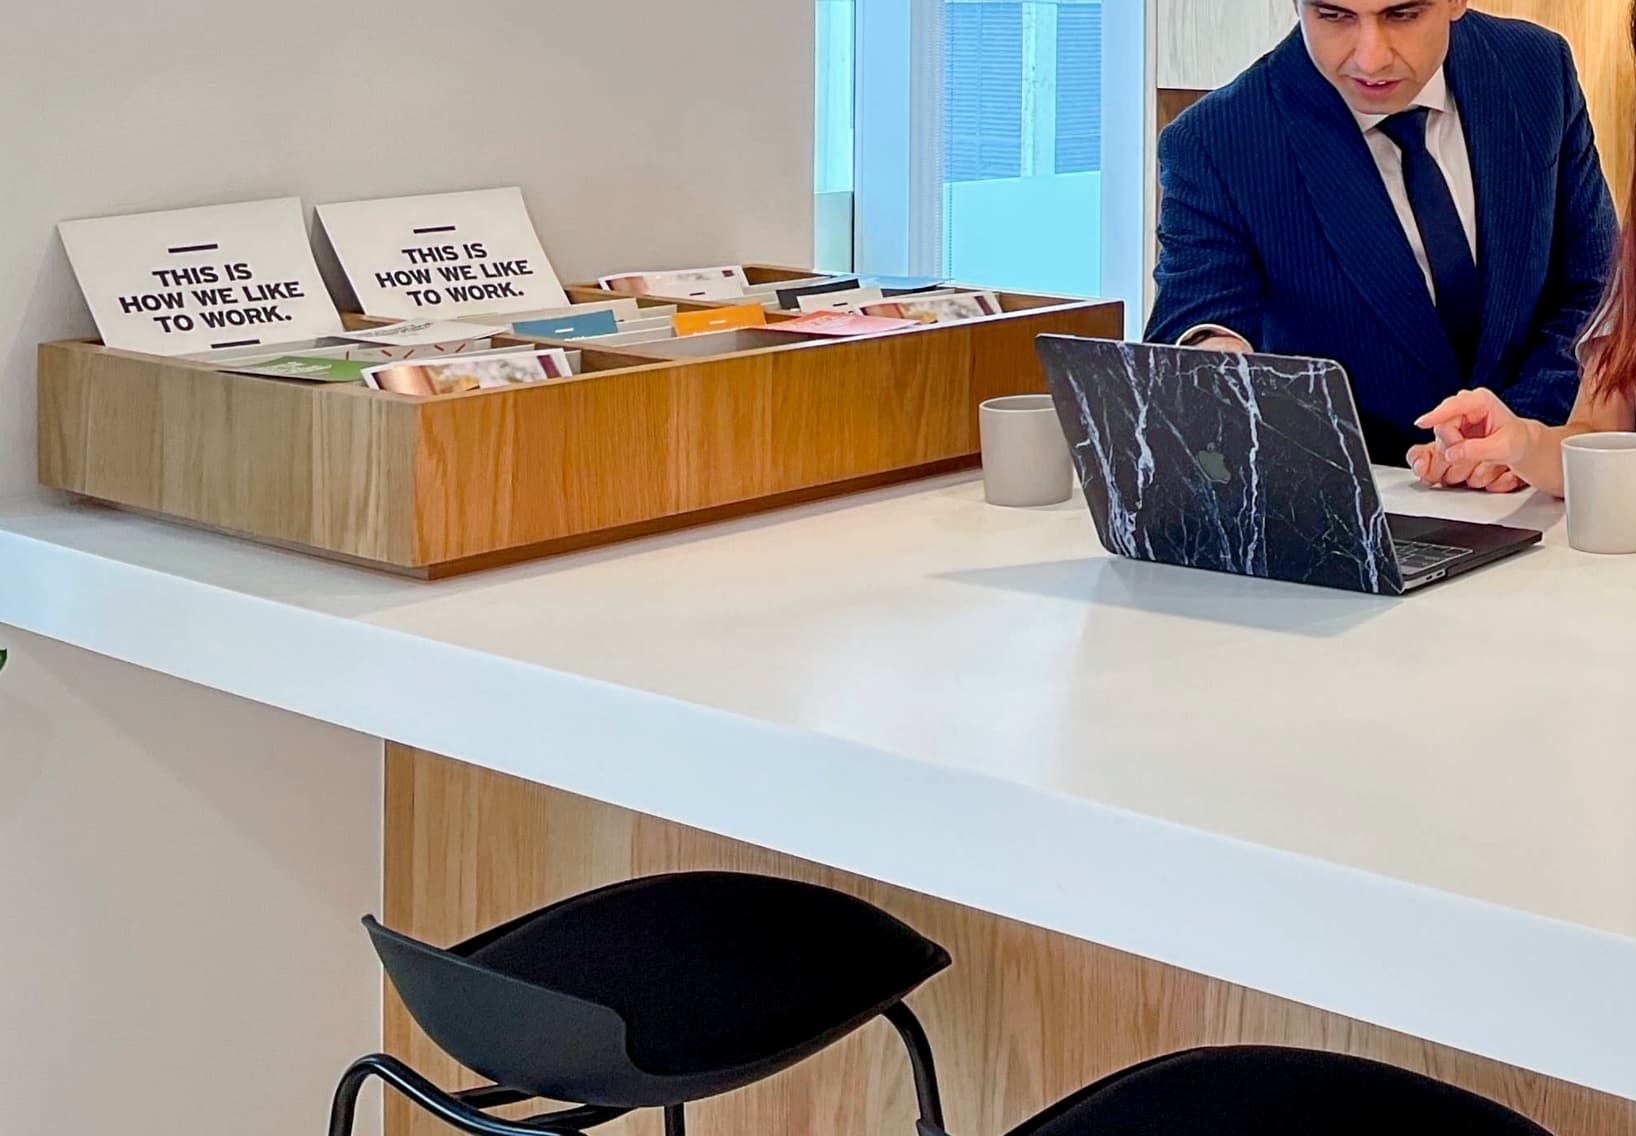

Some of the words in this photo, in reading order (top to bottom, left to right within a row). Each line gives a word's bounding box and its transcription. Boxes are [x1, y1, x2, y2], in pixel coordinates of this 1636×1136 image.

[401, 245, 459, 264] THIS
[463, 243, 487, 259] IS
[152, 266, 219, 287] THIS
[224, 263, 252, 281] IS
[375, 268, 432, 288] HOW
[437, 264, 477, 282] WE
[480, 260, 533, 278] LIKE
[118, 292, 184, 313] HOW
[191, 287, 238, 306] WE
[242, 281, 304, 302] LIKE
[406, 289, 442, 306] TO
[446, 282, 524, 302] WORK.
[153, 315, 194, 333] TO
[199, 305, 292, 329] WORK.
